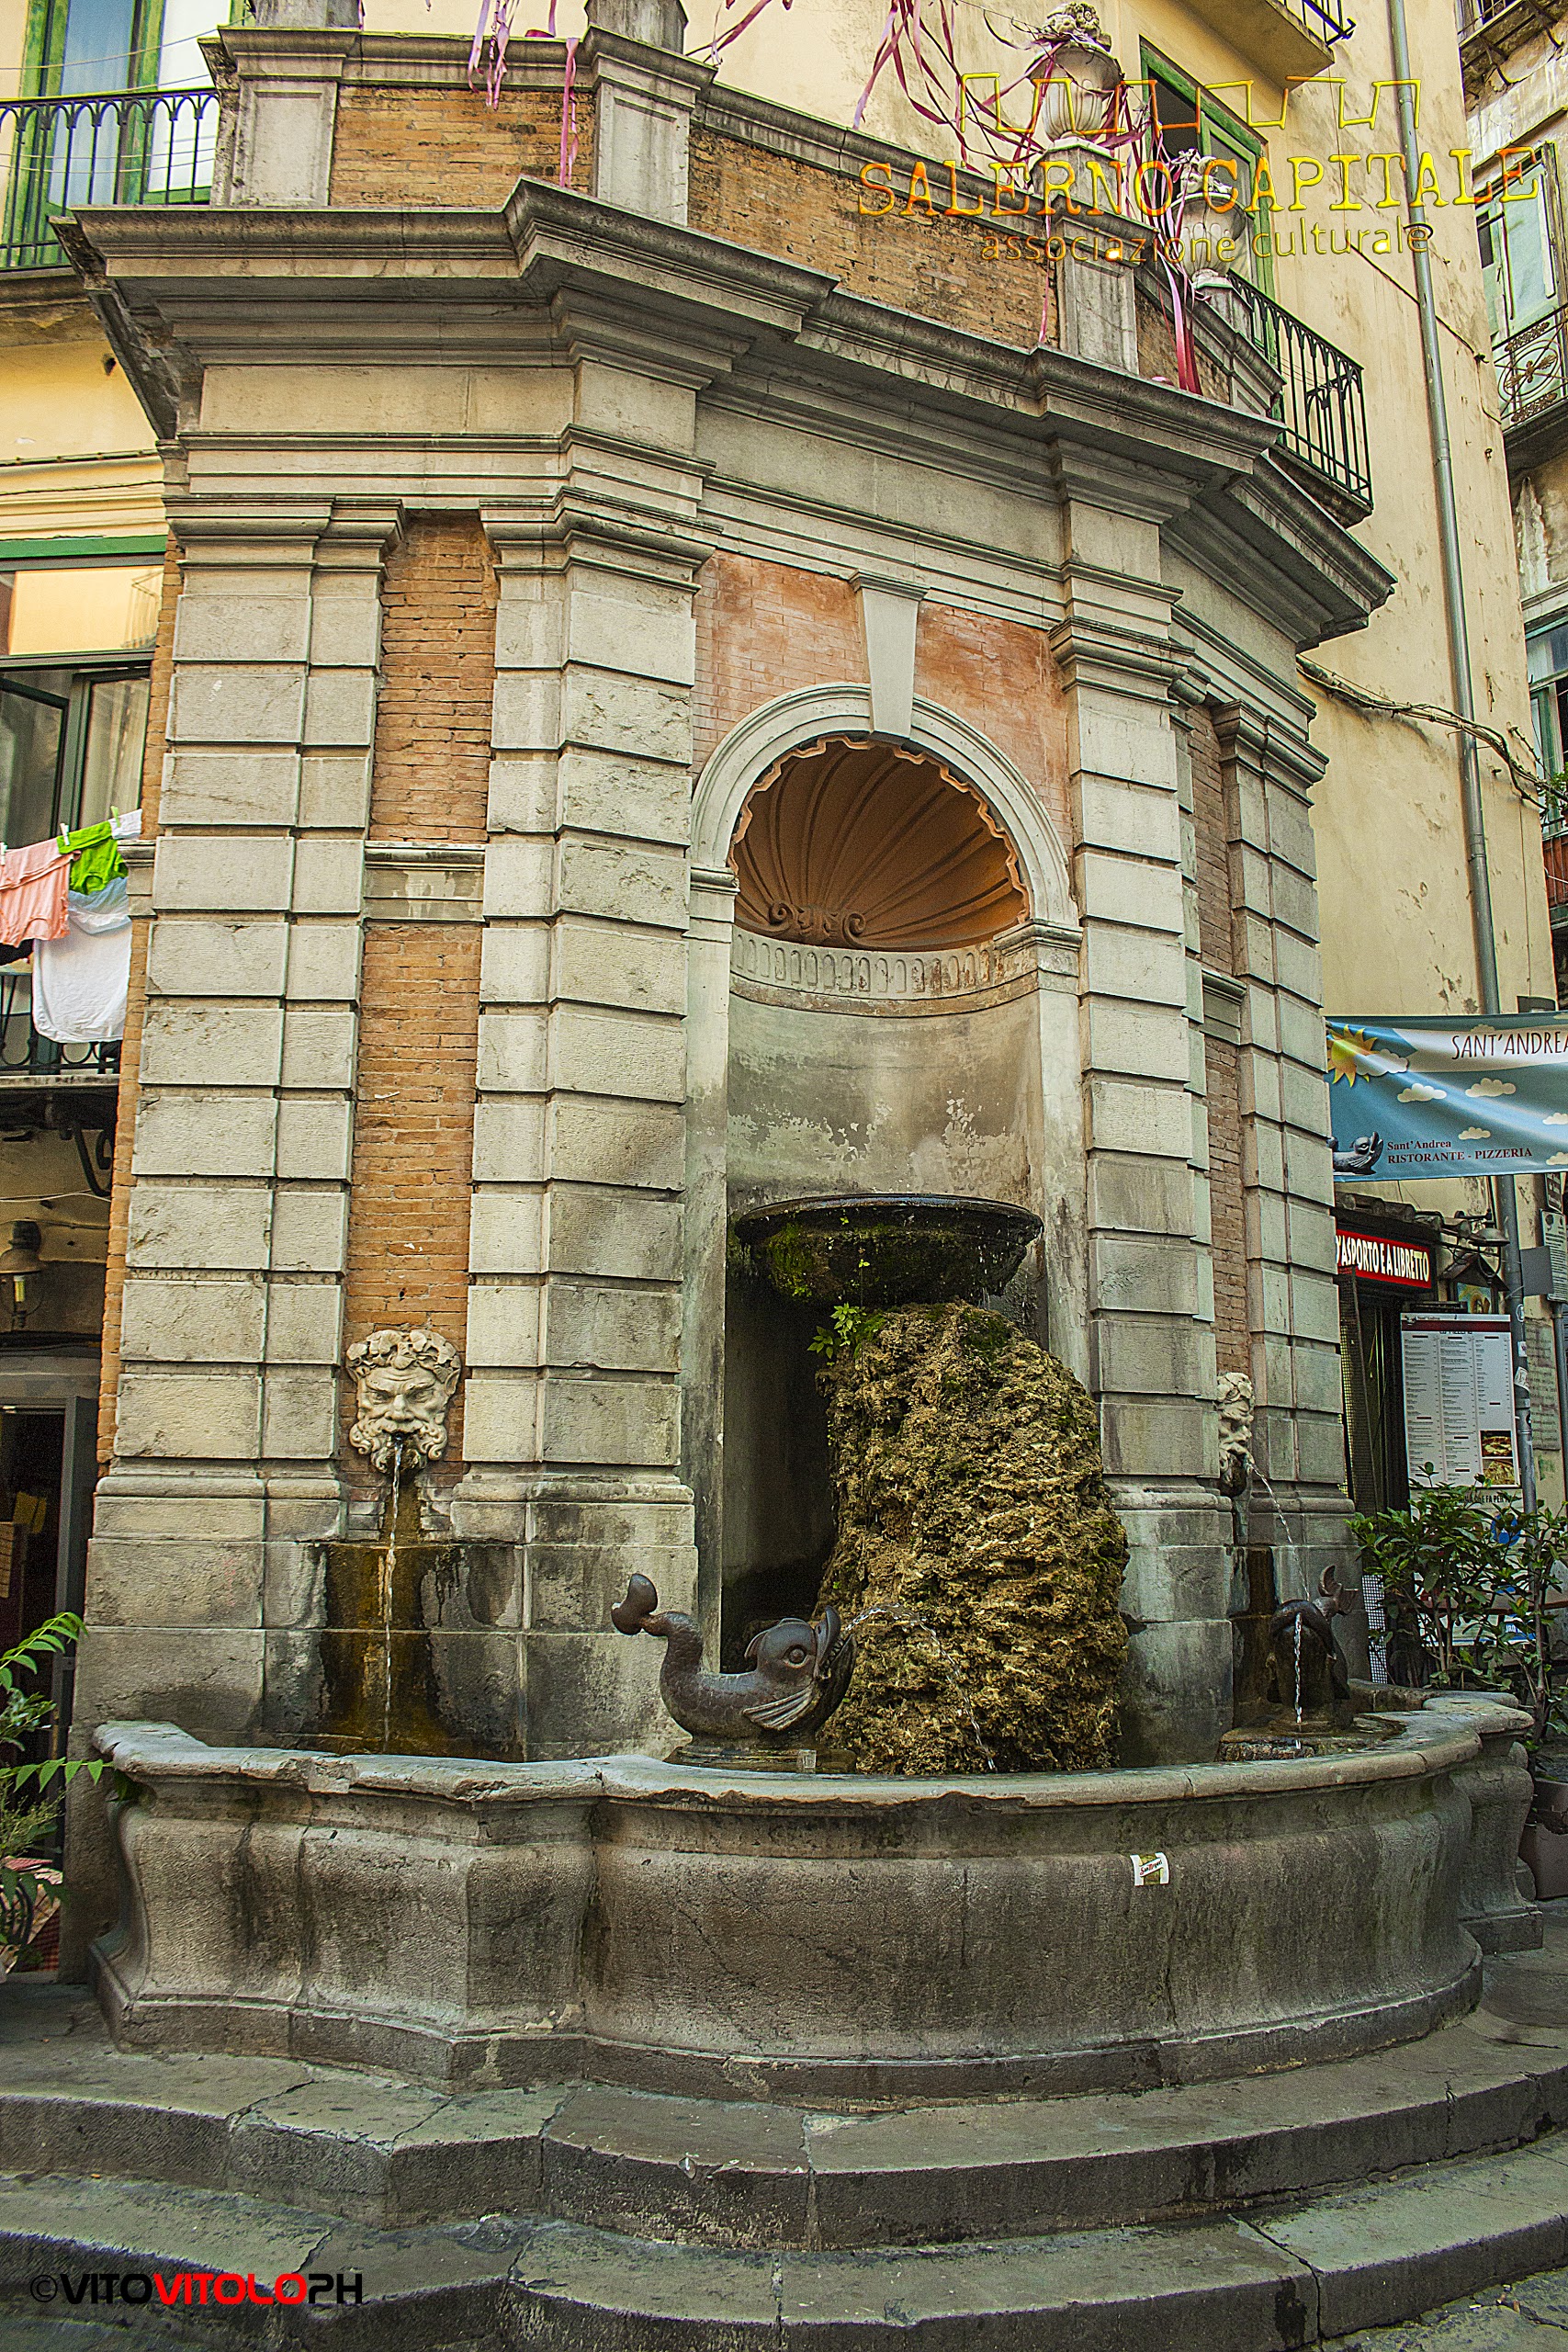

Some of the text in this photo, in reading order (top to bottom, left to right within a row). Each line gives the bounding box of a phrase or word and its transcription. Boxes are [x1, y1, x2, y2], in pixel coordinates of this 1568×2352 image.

[1387, 1139, 1451, 1151] Sant'Andrea
[1387, 1151, 1465, 1164] RISTORANTE
[1474, 1148, 1533, 1159] PIZZERIA
[1380, 1243, 1385, 1275] E
[1386, 1243, 1393, 1276] A
[1393, 1245, 1429, 1283] LIBRETTO
